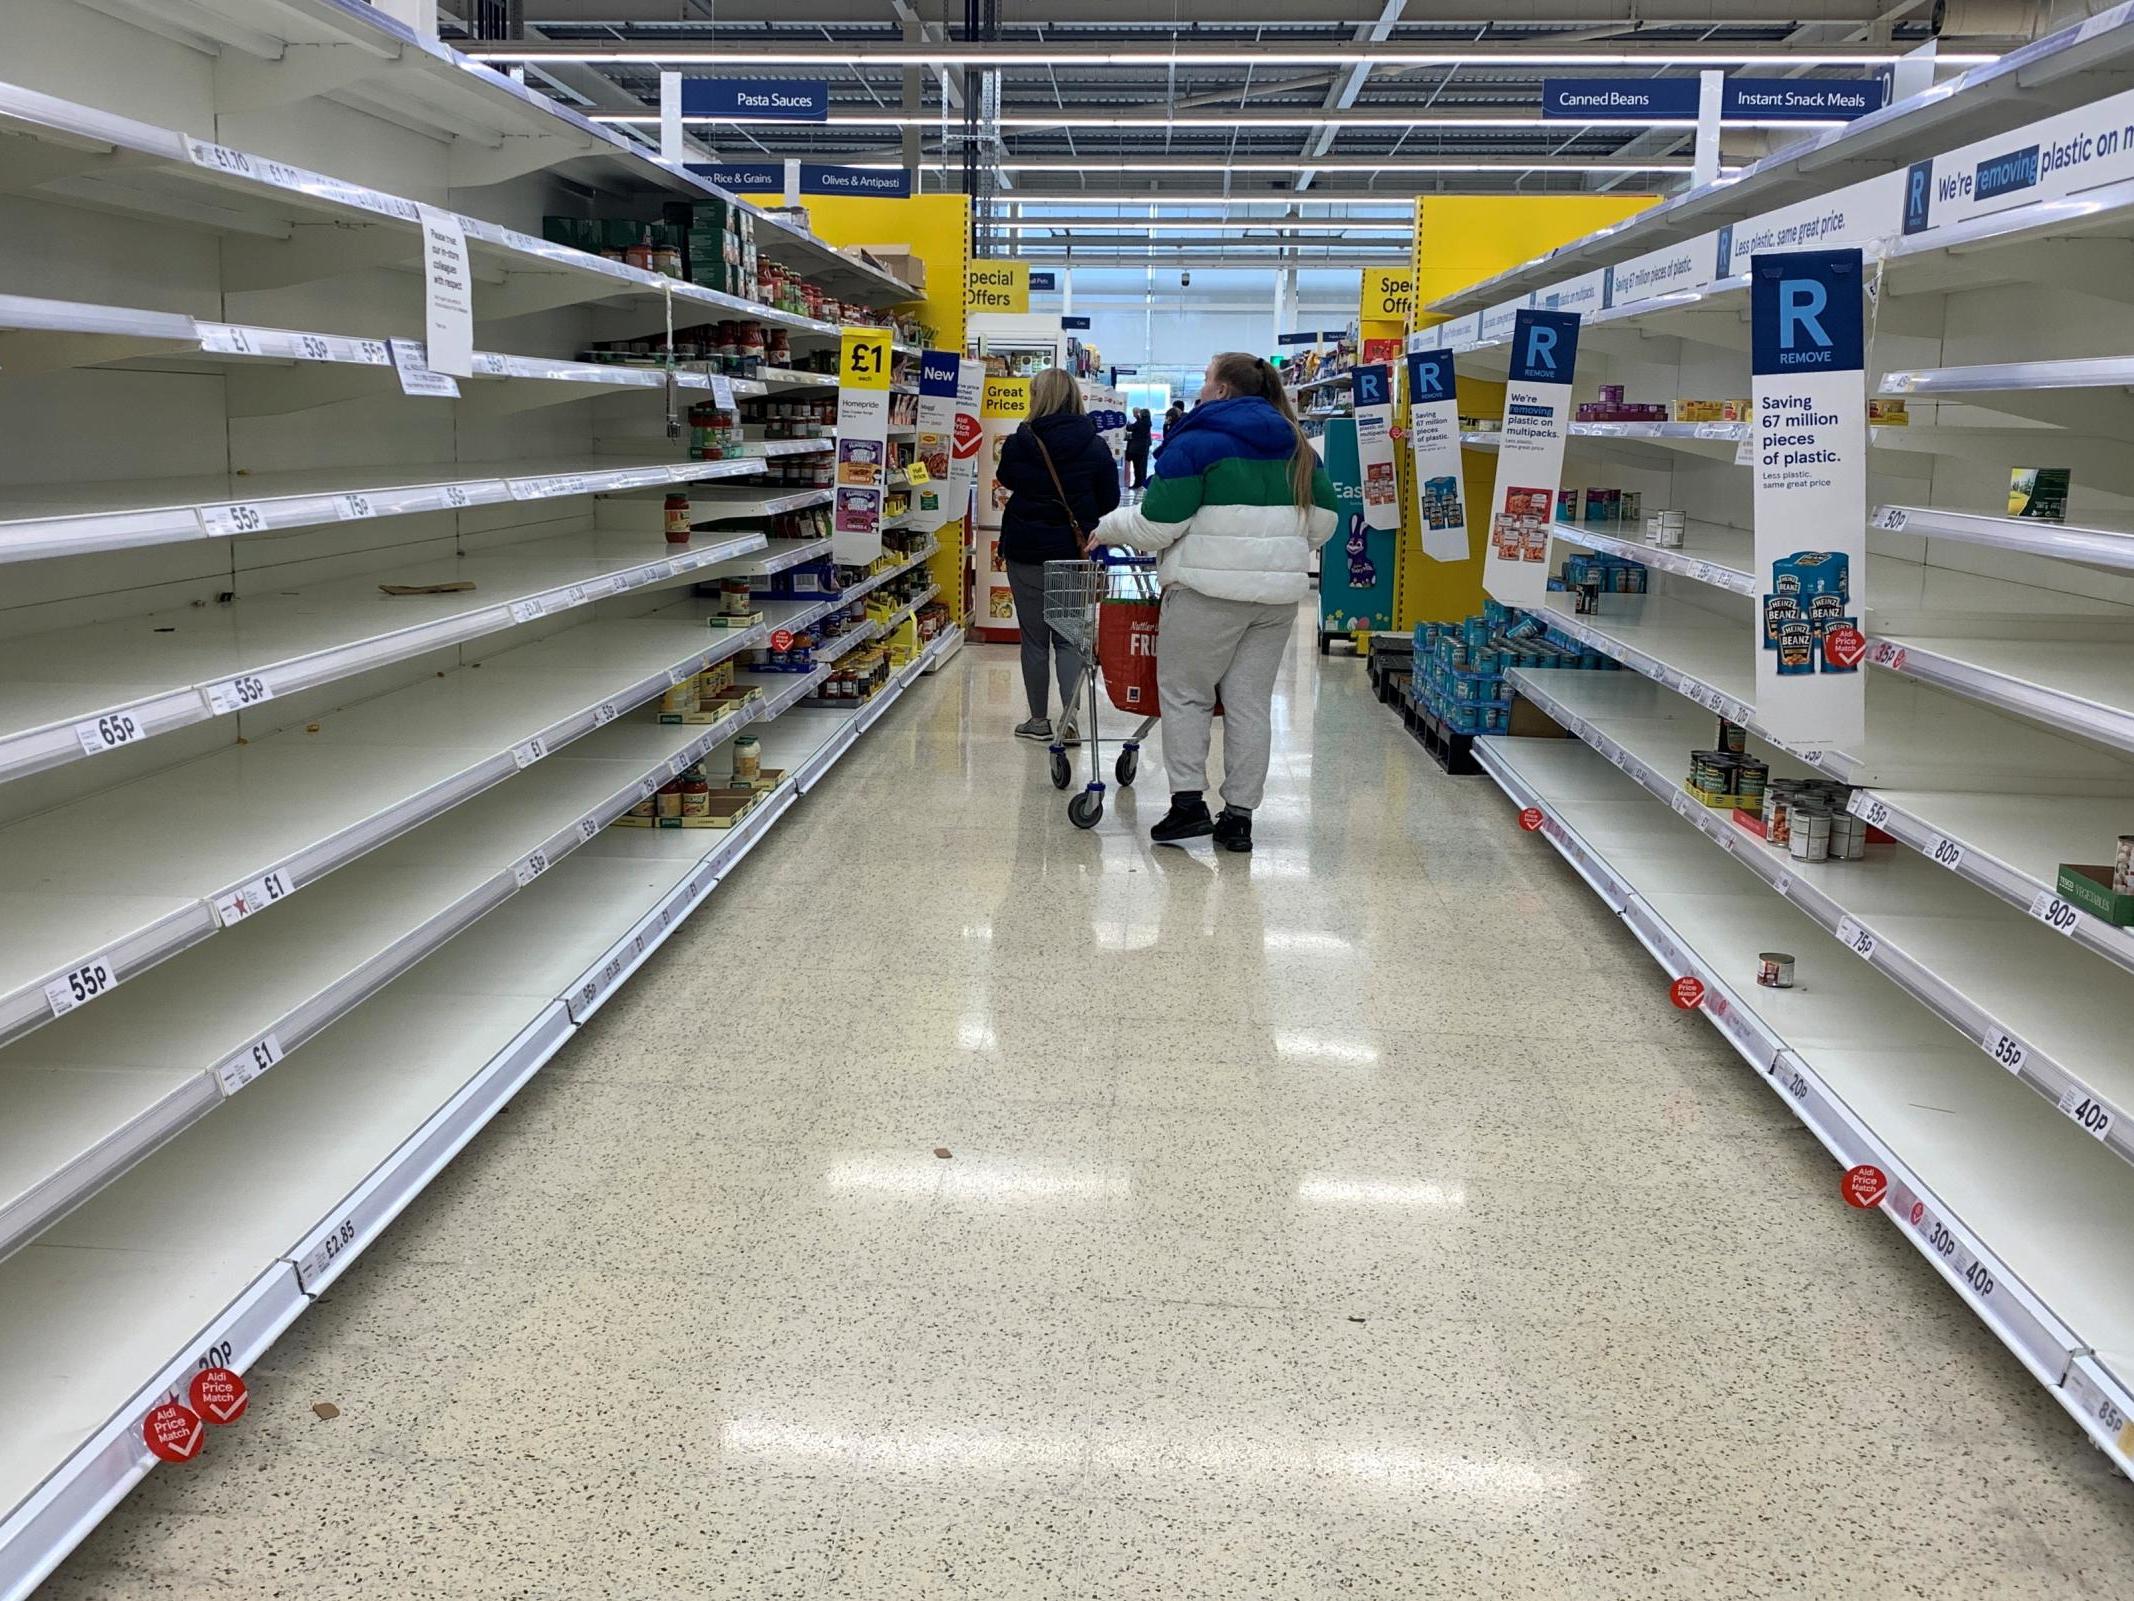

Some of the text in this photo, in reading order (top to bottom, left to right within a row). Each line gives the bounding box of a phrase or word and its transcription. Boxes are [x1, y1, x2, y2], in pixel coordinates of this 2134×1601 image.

[737, 93, 812, 107] Pasta Sauces
[1559, 92, 1649, 106] Canned Beans
[1738, 91, 1866, 108] Instant Snack Meals
[214, 147, 249, 172] £1.70
[1939, 130, 2118, 202] We're removing plastic on
[713, 173, 772, 184] Rice & Grains
[821, 174, 899, 188] Olives & Antipasti
[1910, 170, 1925, 217] R
[1735, 238, 1750, 257] Less
[1777, 225, 1798, 245] same
[1798, 217, 1820, 245] great
[969, 269, 1014, 290] pecial
[1779, 278, 1833, 348] R
[230, 328, 251, 353] £1
[303, 335, 328, 360] 53p
[1526, 325, 1558, 369] R
[850, 343, 882, 373] £1
[1779, 351, 1832, 364] REMOVE
[924, 366, 955, 382] New
[1418, 362, 1444, 393] R
[1524, 368, 1556, 378] REMOVE
[987, 385, 1024, 398] Great
[1360, 374, 1380, 399] R
[842, 399, 880, 409] Homepride
[986, 399, 1025, 412] Prices
[1511, 393, 1538, 403] We're
[1762, 395, 1812, 411] Saving
[1415, 410, 1437, 421] Saving
[1509, 405, 1553, 417] removing
[1425, 418, 1448, 426] million
[1508, 416, 1553, 427] plastic on
[1762, 412, 1838, 428] 67 million
[1416, 428, 1439, 437] pieces
[1507, 427, 1560, 439] multipacks.
[1763, 434, 1815, 450] pieces
[1762, 449, 1841, 468] of plastic.
[1762, 471, 1781, 480] Less
[1763, 479, 1831, 490] same great price
[345, 495, 369, 517] 75p
[229, 507, 259, 531] 55p
[1884, 510, 1905, 530] 50p
[1779, 583, 1798, 591] BEANZ
[1771, 599, 1793, 608] HEINZ
[1815, 599, 1837, 607] HEINZ
[1769, 609, 1797, 620] BEANZ
[1812, 608, 1840, 619] BEANZ
[1785, 625, 1807, 634] HEINZ
[1781, 635, 1810, 645] BEANZ
[1835, 637, 1857, 645] Price
[1834, 645, 1857, 653] Match
[235, 676, 264, 705] 55p
[1734, 706, 1748, 724] 70p
[100, 713, 136, 748] 65p
[530, 740, 543, 758] £1
[1866, 802, 1888, 825] 55p
[1935, 839, 1960, 865] 80p
[529, 854, 546, 875] 53p
[265, 873, 285, 900] £1
[2060, 875, 2074, 889] TESCO
[2044, 899, 2076, 930] 90p
[1852, 930, 1873, 955] 75p
[68, 965, 107, 1002] 55p
[252, 1040, 274, 1071] £1
[1995, 1035, 2022, 1067] 55p
[1789, 1073, 1808, 1101] 20p
[2073, 1097, 2109, 1133] 40p
[1858, 1168, 1875, 1176] Aldi
[1851, 1183, 1877, 1193] Match
[1852, 1175, 1878, 1186] Price
[325, 1219, 355, 1260] £2.85
[1929, 1221, 1955, 1258] 30p
[1965, 1260, 1994, 1297] 40p
[206, 1372, 227, 1382] Aldi
[201, 1381, 234, 1393] Price
[202, 1391, 235, 1403] Match
[156, 1407, 177, 1422] Aldi
[2098, 1400, 2123, 1434] 85p
[153, 1417, 186, 1433] Price
[157, 1427, 191, 1444] Match
